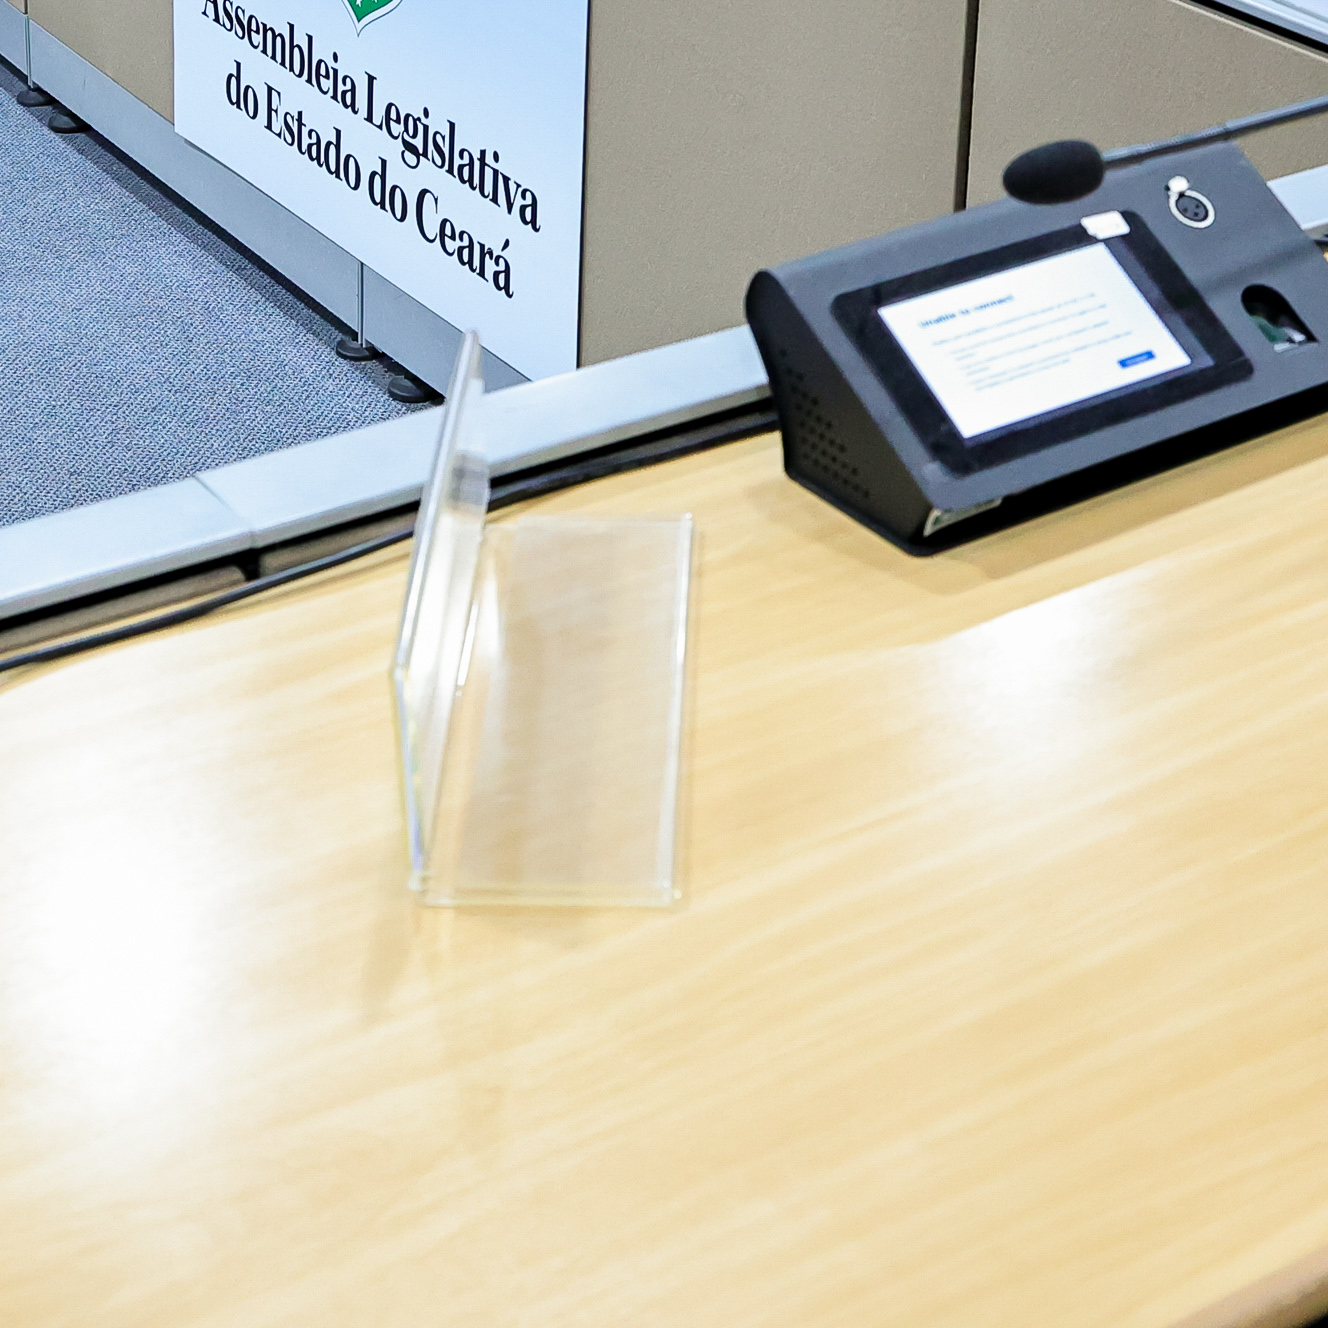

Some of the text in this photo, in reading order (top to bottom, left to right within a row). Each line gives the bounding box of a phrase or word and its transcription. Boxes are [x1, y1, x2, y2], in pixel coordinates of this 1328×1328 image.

[225, 59, 514, 299] do Estado do Ceará
[363, 71, 541, 233] Legislativa
